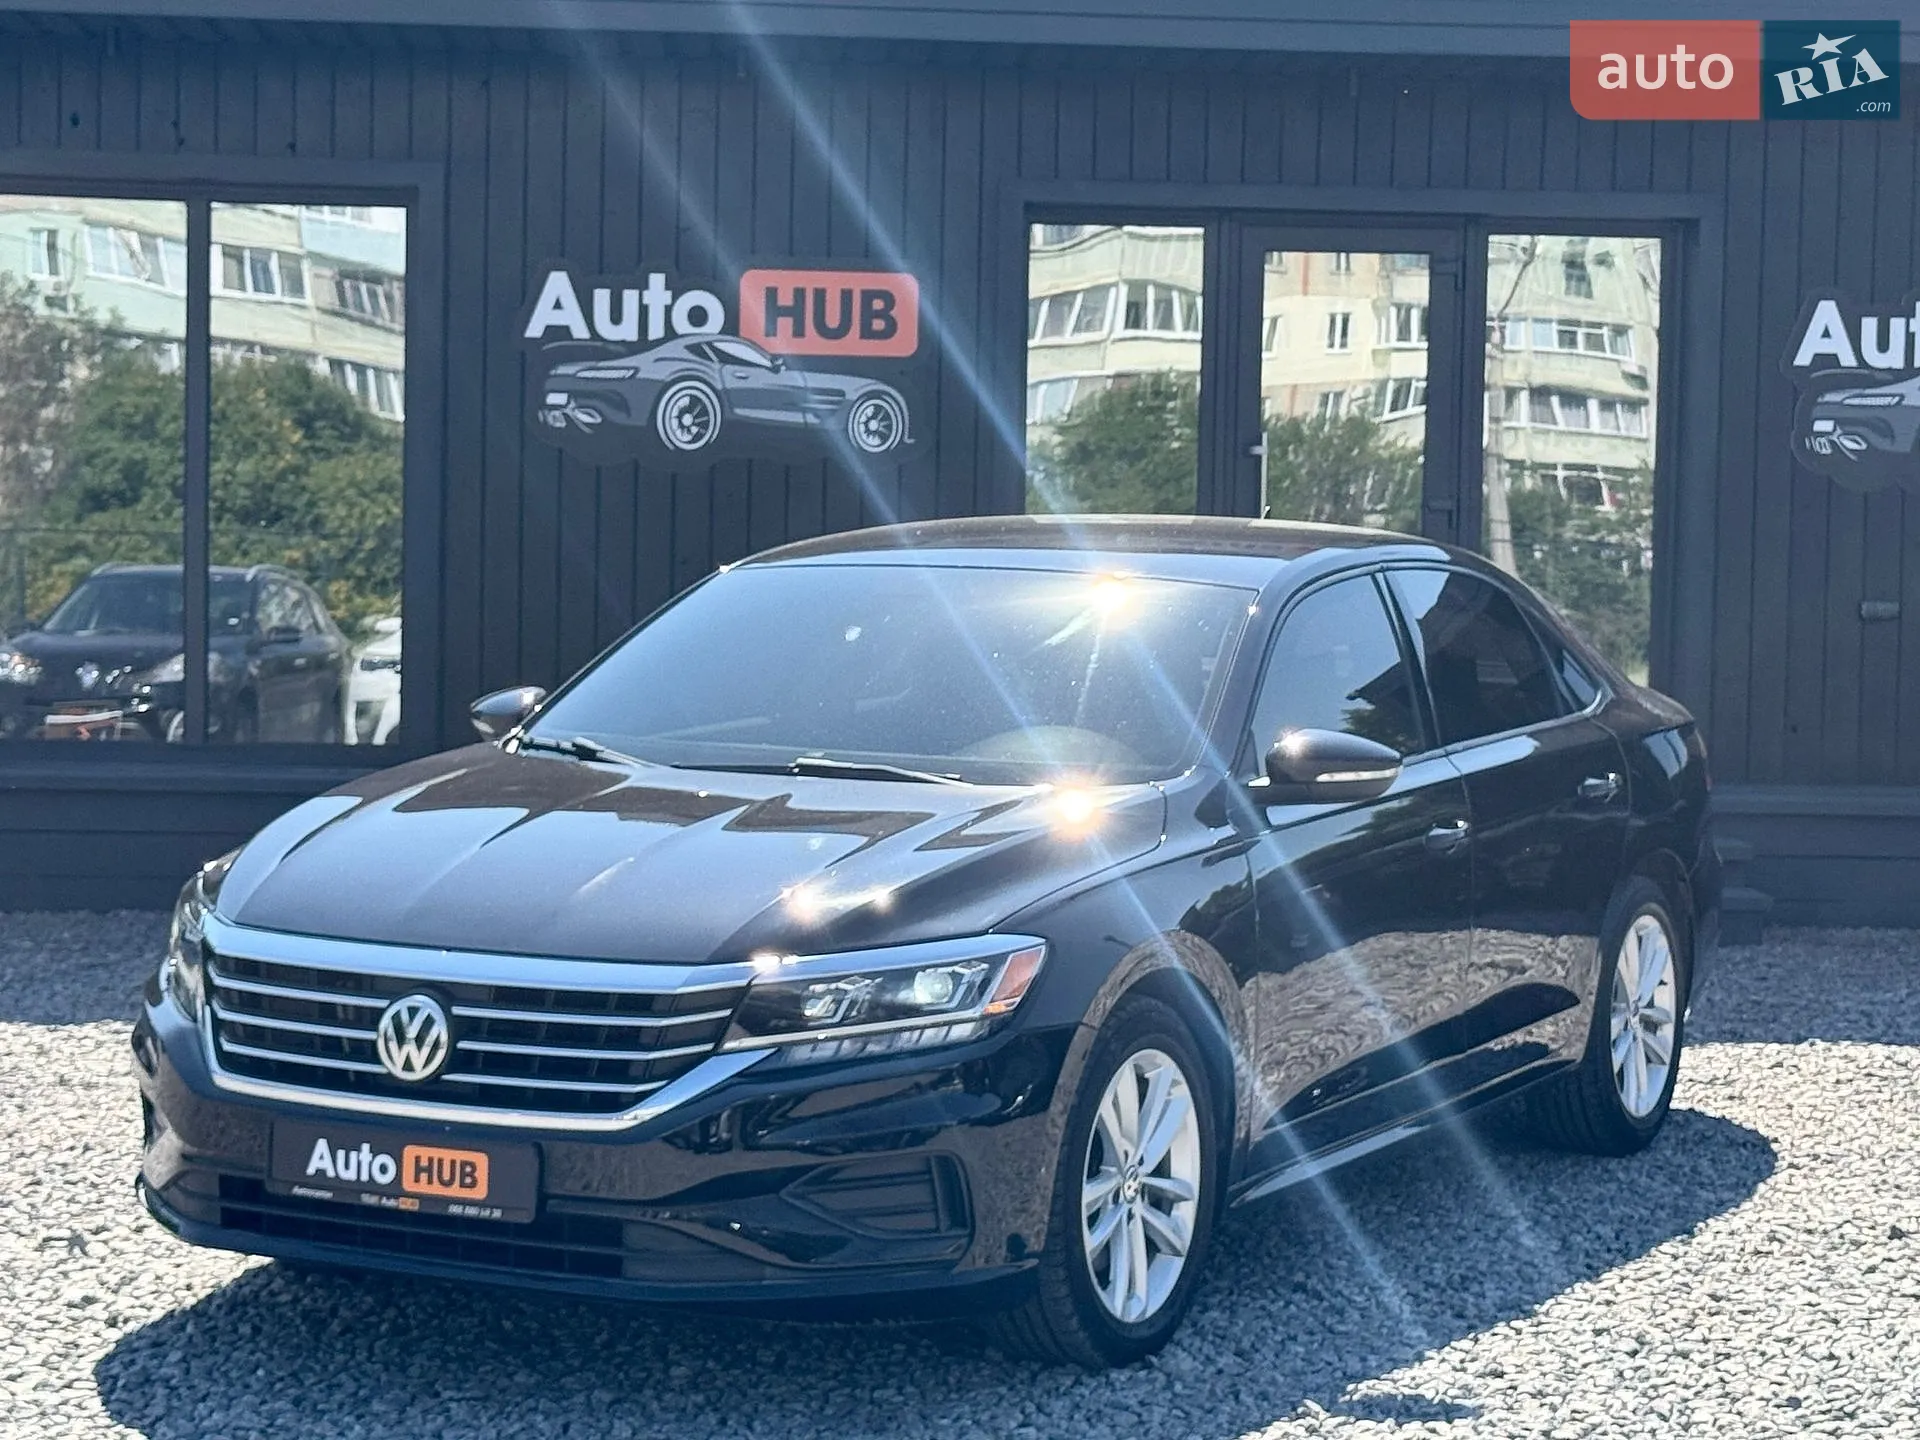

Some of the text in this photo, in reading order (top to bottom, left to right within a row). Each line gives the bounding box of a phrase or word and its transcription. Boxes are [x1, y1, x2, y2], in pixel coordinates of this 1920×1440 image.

[523, 270, 899, 341] Auto HUB
[305, 1137, 478, 1189] Auto HUB
